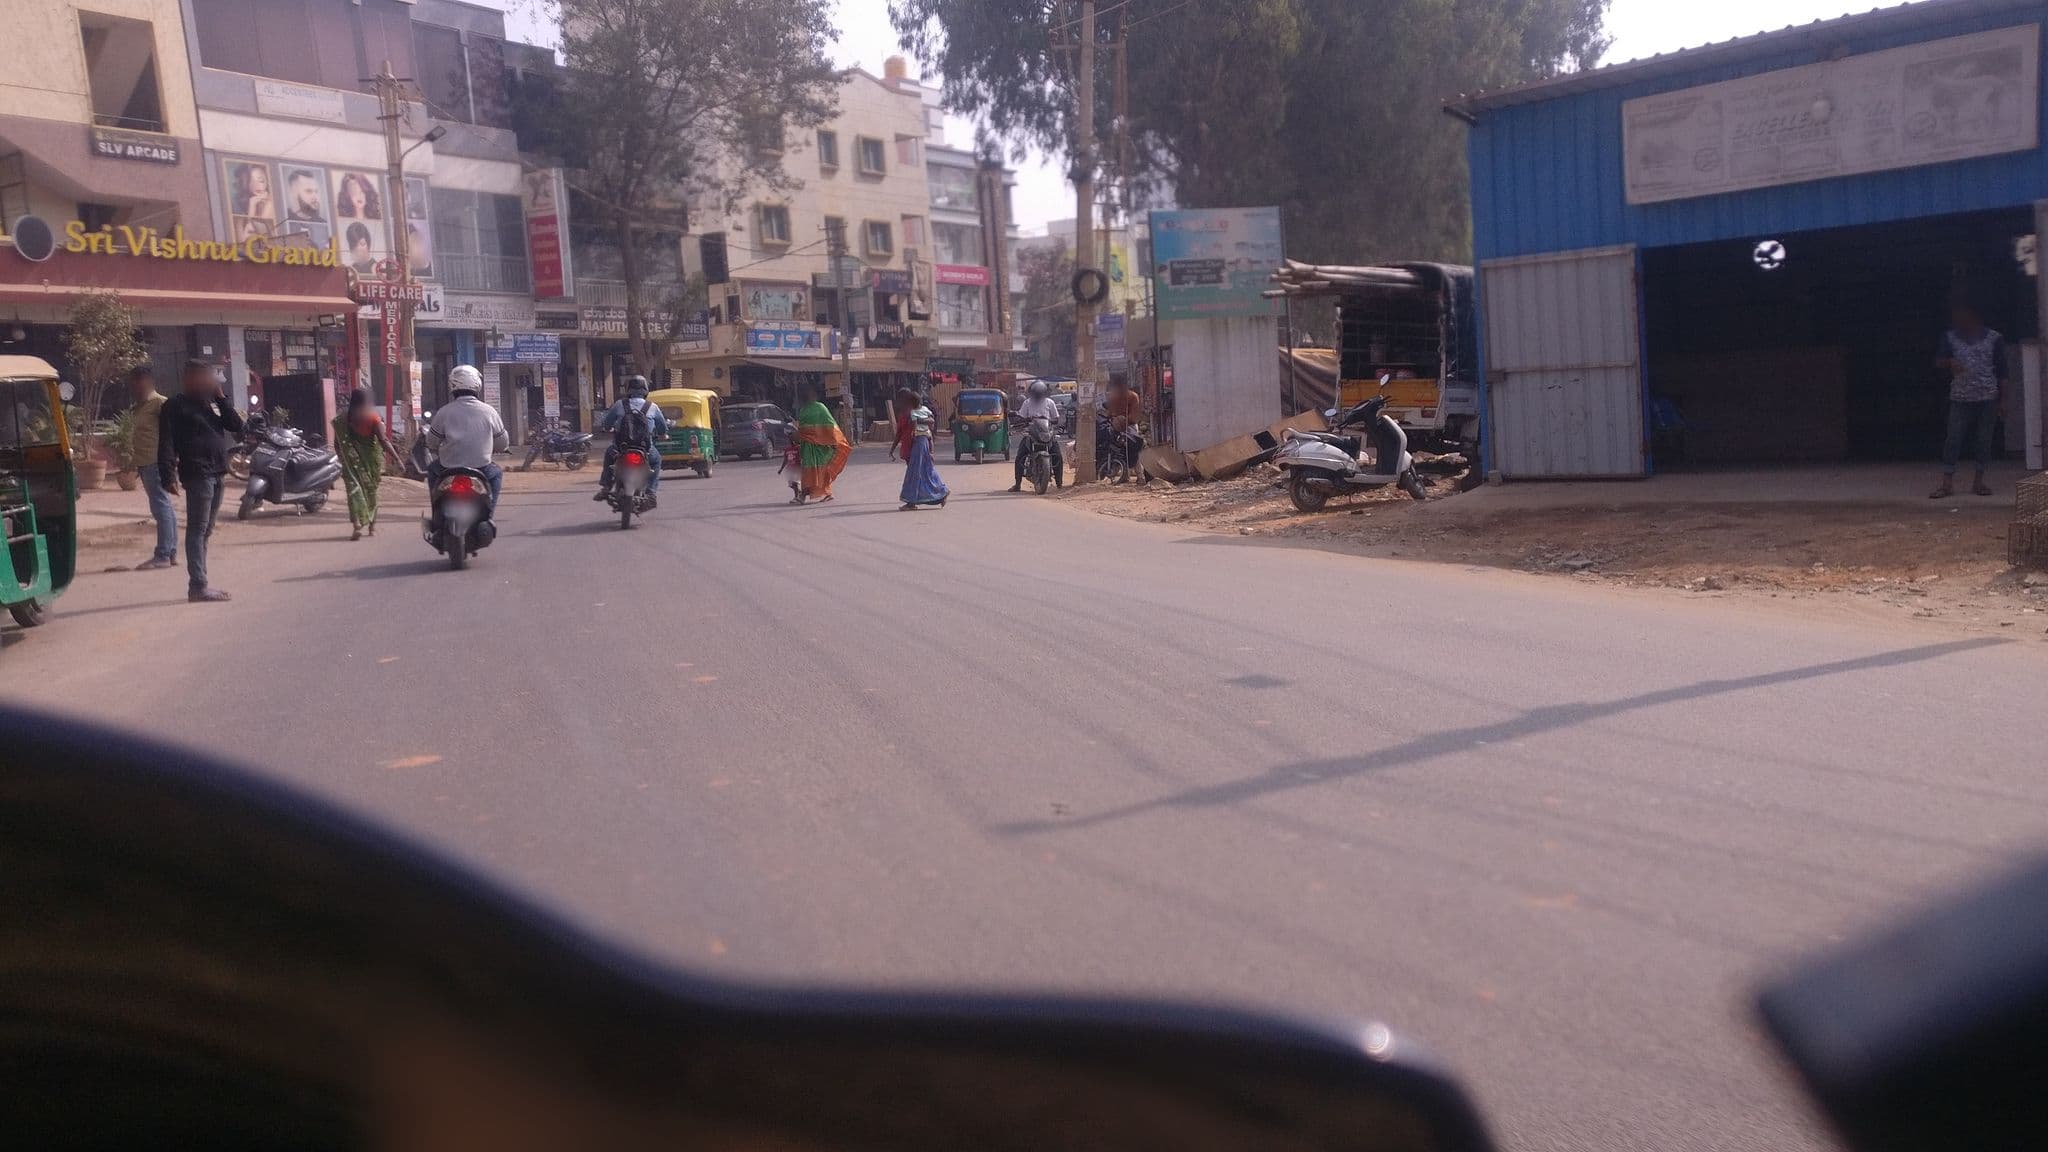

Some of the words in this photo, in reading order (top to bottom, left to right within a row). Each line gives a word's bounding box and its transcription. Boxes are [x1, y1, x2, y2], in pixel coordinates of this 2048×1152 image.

[98, 142, 122, 154] SLV
[127, 145, 176, 160] ARCADE
[65, 220, 115, 254] Sri
[119, 224, 240, 262] Vishnu
[247, 234, 341, 267] Grand
[359, 284, 386, 298] LIFE
[389, 285, 422, 300] CARE
[385, 301, 398, 365] MEDICALS
